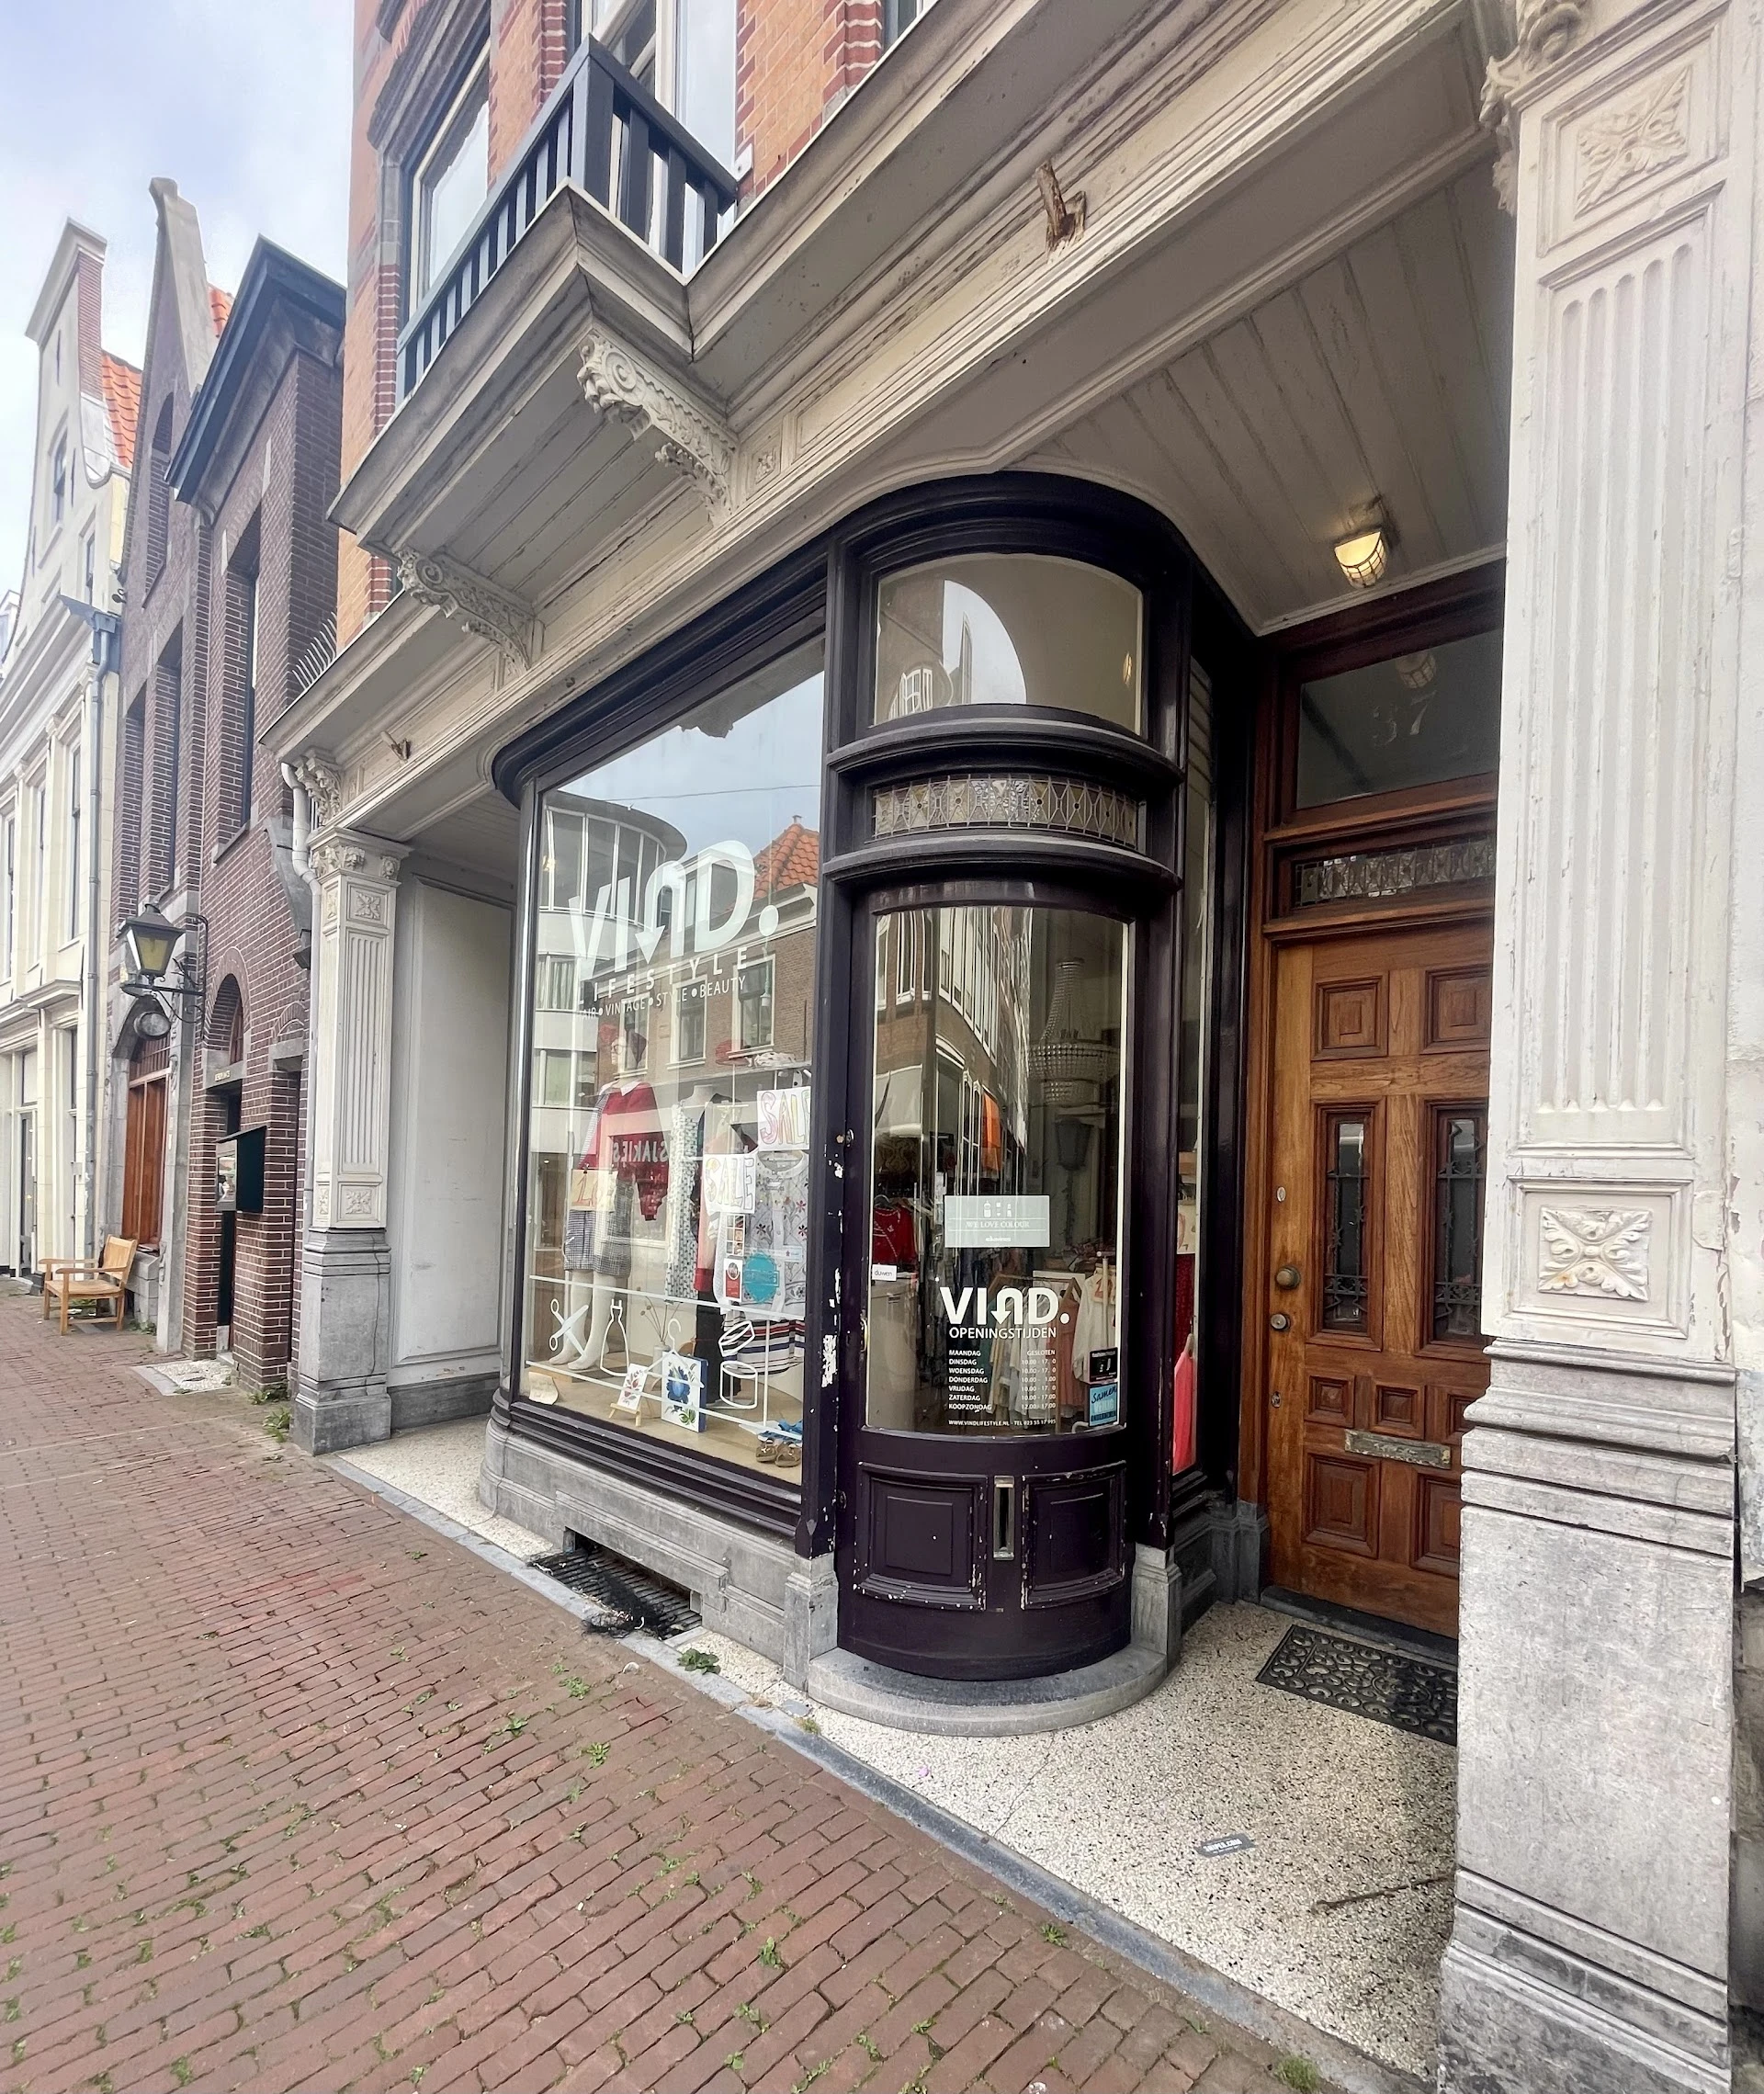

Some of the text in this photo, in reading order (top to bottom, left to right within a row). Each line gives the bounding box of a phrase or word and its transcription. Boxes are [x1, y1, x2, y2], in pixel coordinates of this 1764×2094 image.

[605, 998, 646, 1016] VINTAGE
[699, 975, 747, 999] BEAUTY
[705, 1157, 755, 1210] SALE
[949, 1327, 1057, 1339] OPENINGSTIJDEN
